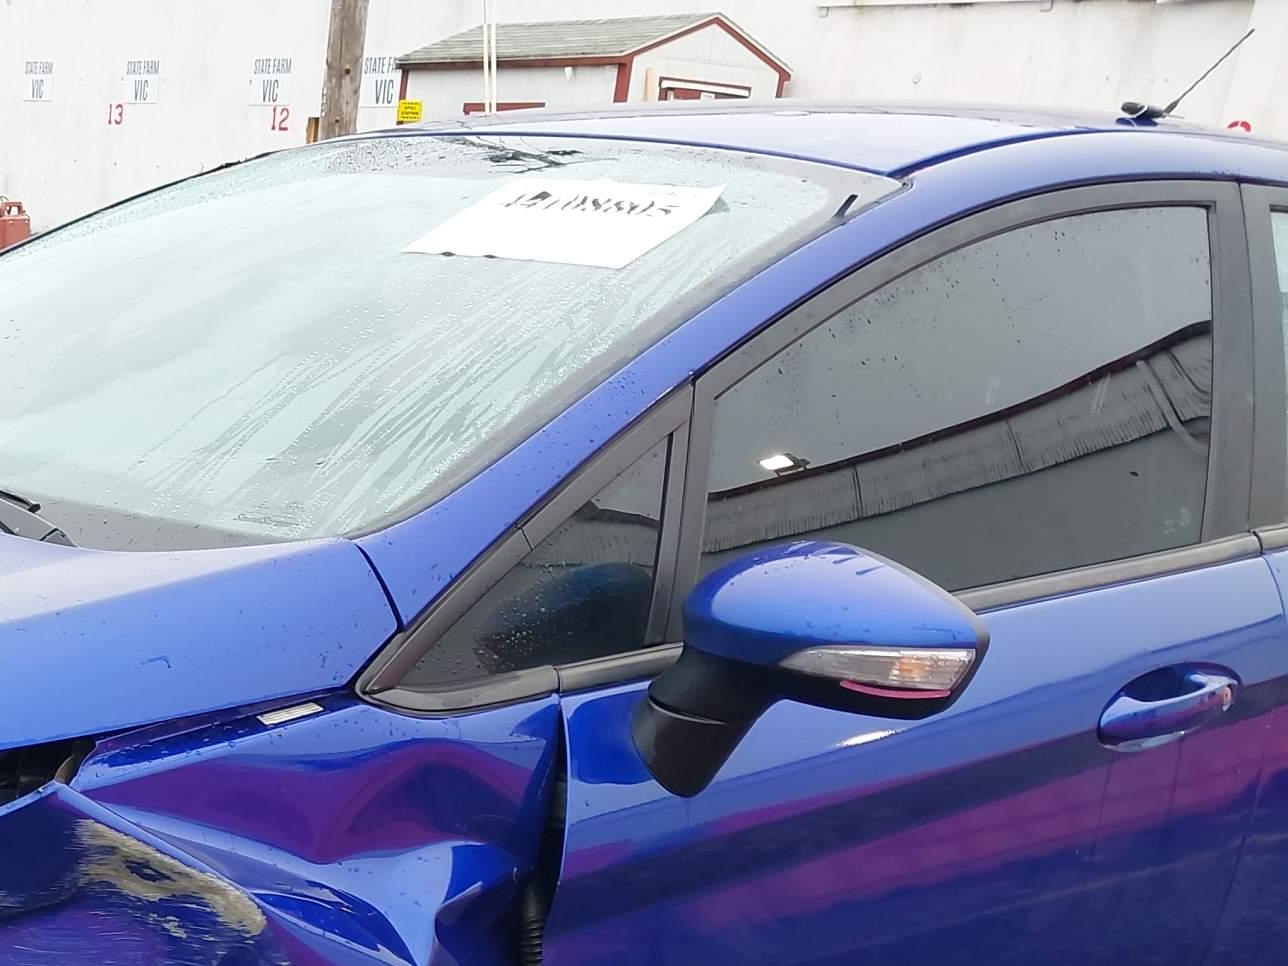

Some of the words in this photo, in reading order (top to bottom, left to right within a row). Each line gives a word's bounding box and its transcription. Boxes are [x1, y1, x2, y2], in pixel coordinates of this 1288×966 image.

[126, 60, 142, 75] STATE
[143, 60, 159, 75] FARM
[254, 58, 271, 74] STATE
[272, 58, 292, 74] FARM
[364, 56, 386, 74] STATE
[32, 79, 44, 99] VIC
[135, 80, 148, 101] VIC
[263, 80, 279, 103] VIC
[375, 79, 394, 104] VIC
[108, 103, 123, 125] 13
[271, 105, 289, 131] 12
